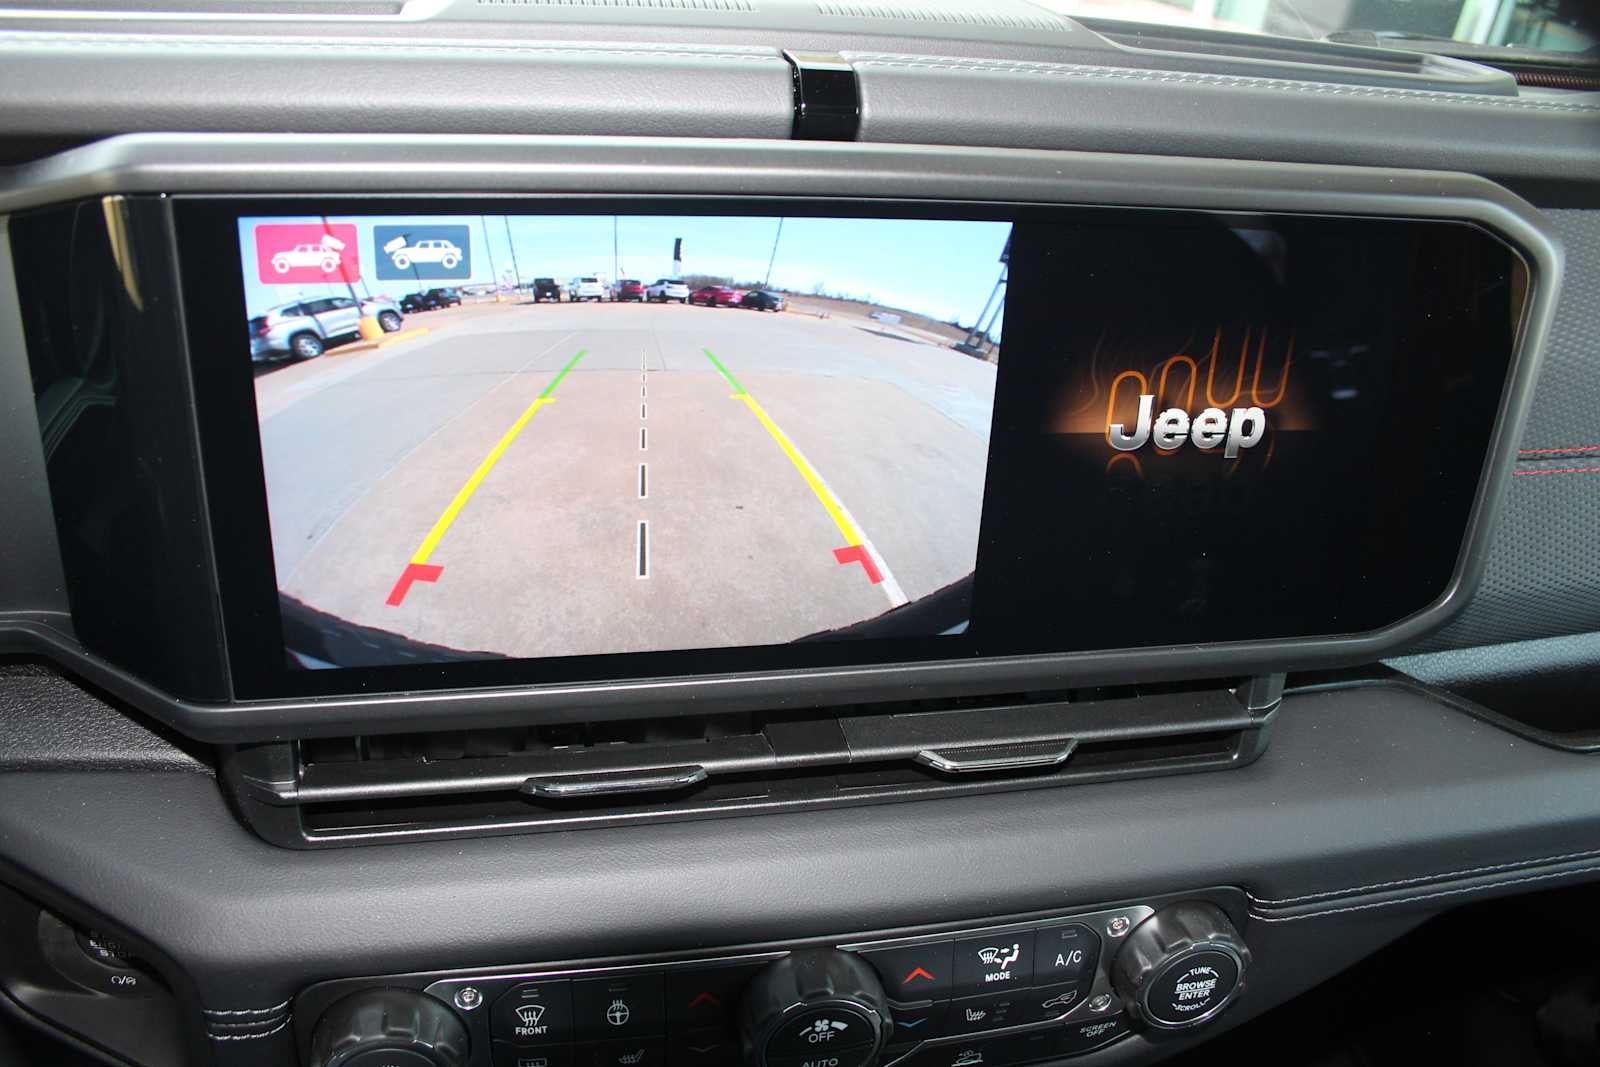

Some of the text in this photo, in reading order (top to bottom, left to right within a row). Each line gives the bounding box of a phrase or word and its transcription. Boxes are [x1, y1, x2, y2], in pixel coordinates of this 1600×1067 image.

[1109, 394, 1265, 459] Jeep
[1055, 950, 1082, 966] A/C
[985, 971, 1010, 982] MODE
[1189, 966, 1212, 976] TUNE
[1176, 978, 1217, 991] BROWSE
[1178, 990, 1211, 1001] ENTER
[515, 1025, 548, 1036] FRONT
[1079, 1021, 1117, 1034] SCREEN
[1086, 1028, 1106, 1038] OFF
[808, 1031, 836, 1044] OFF
